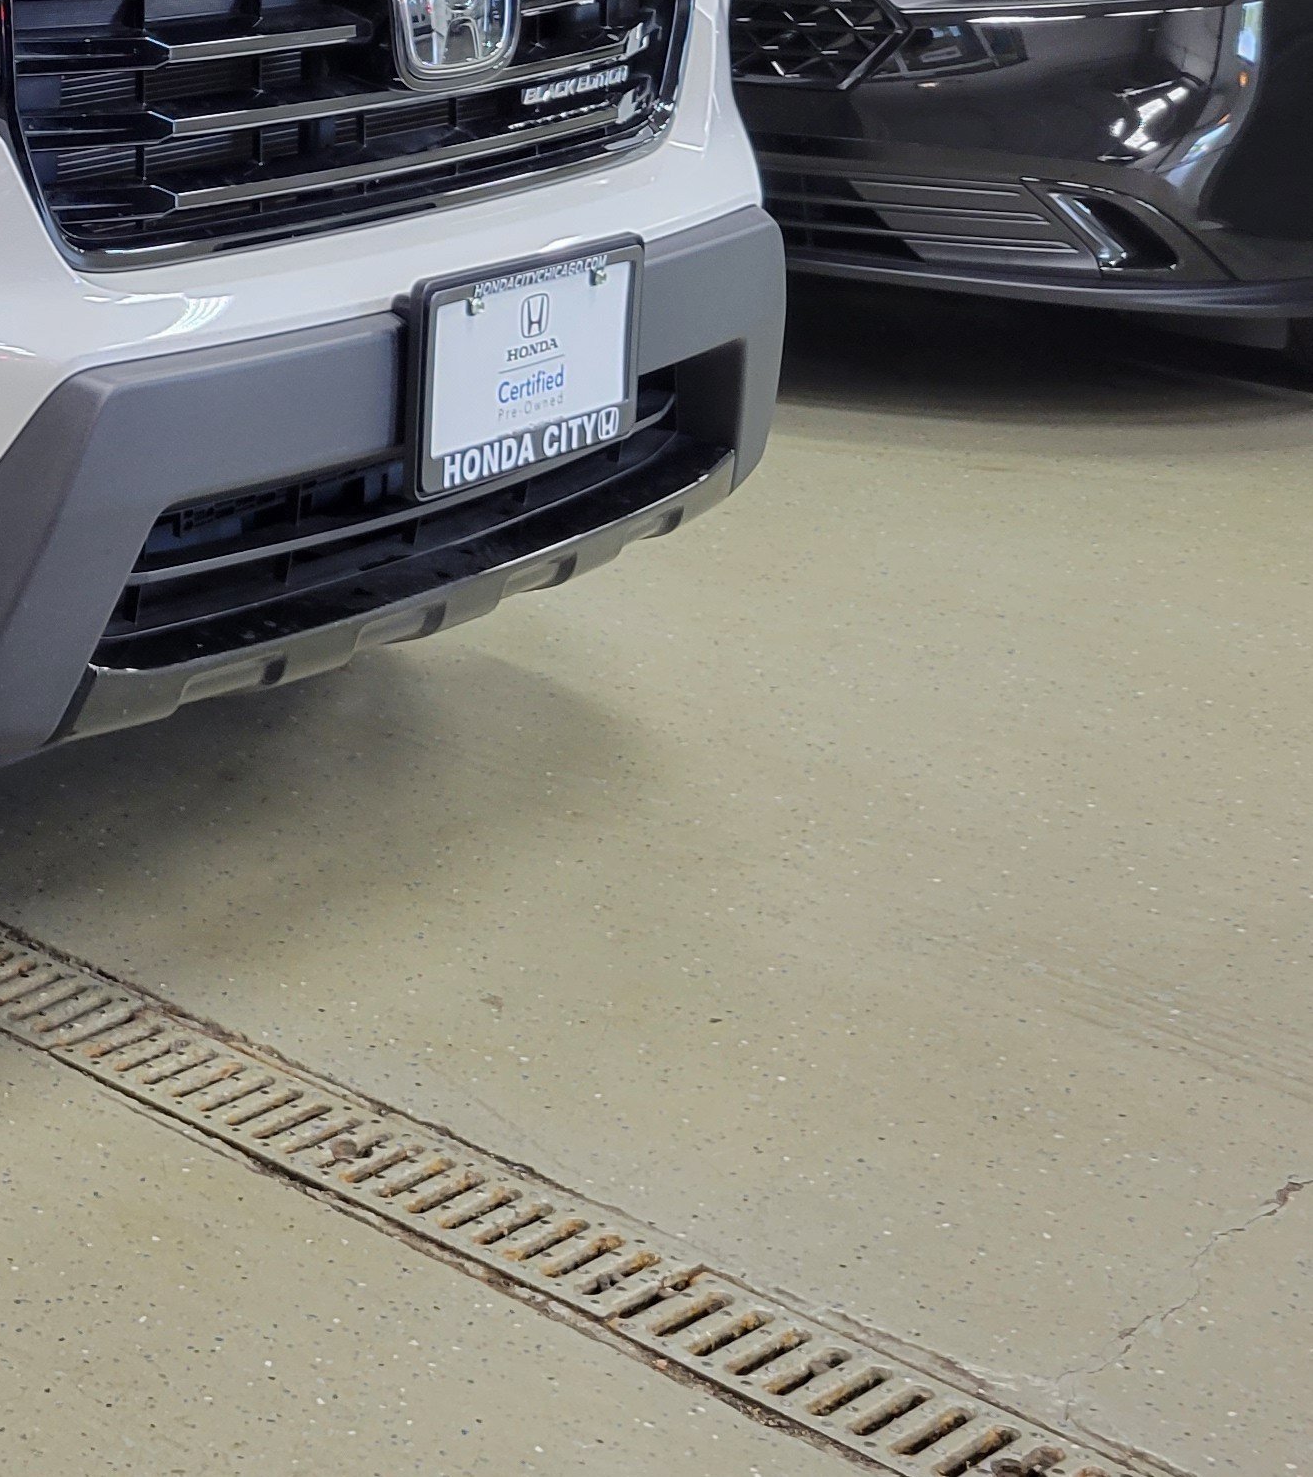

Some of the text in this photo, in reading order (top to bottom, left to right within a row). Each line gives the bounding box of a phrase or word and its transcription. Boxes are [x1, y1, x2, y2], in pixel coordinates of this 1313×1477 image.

[521, 65, 630, 106] BLACK EDITION
[473, 254, 608, 298] HONDACITYCHICAGO.COM
[505, 337, 560, 362] HONDA
[498, 363, 565, 404] Certified
[442, 436, 536, 489] HONDA
[542, 413, 599, 458] CITY
